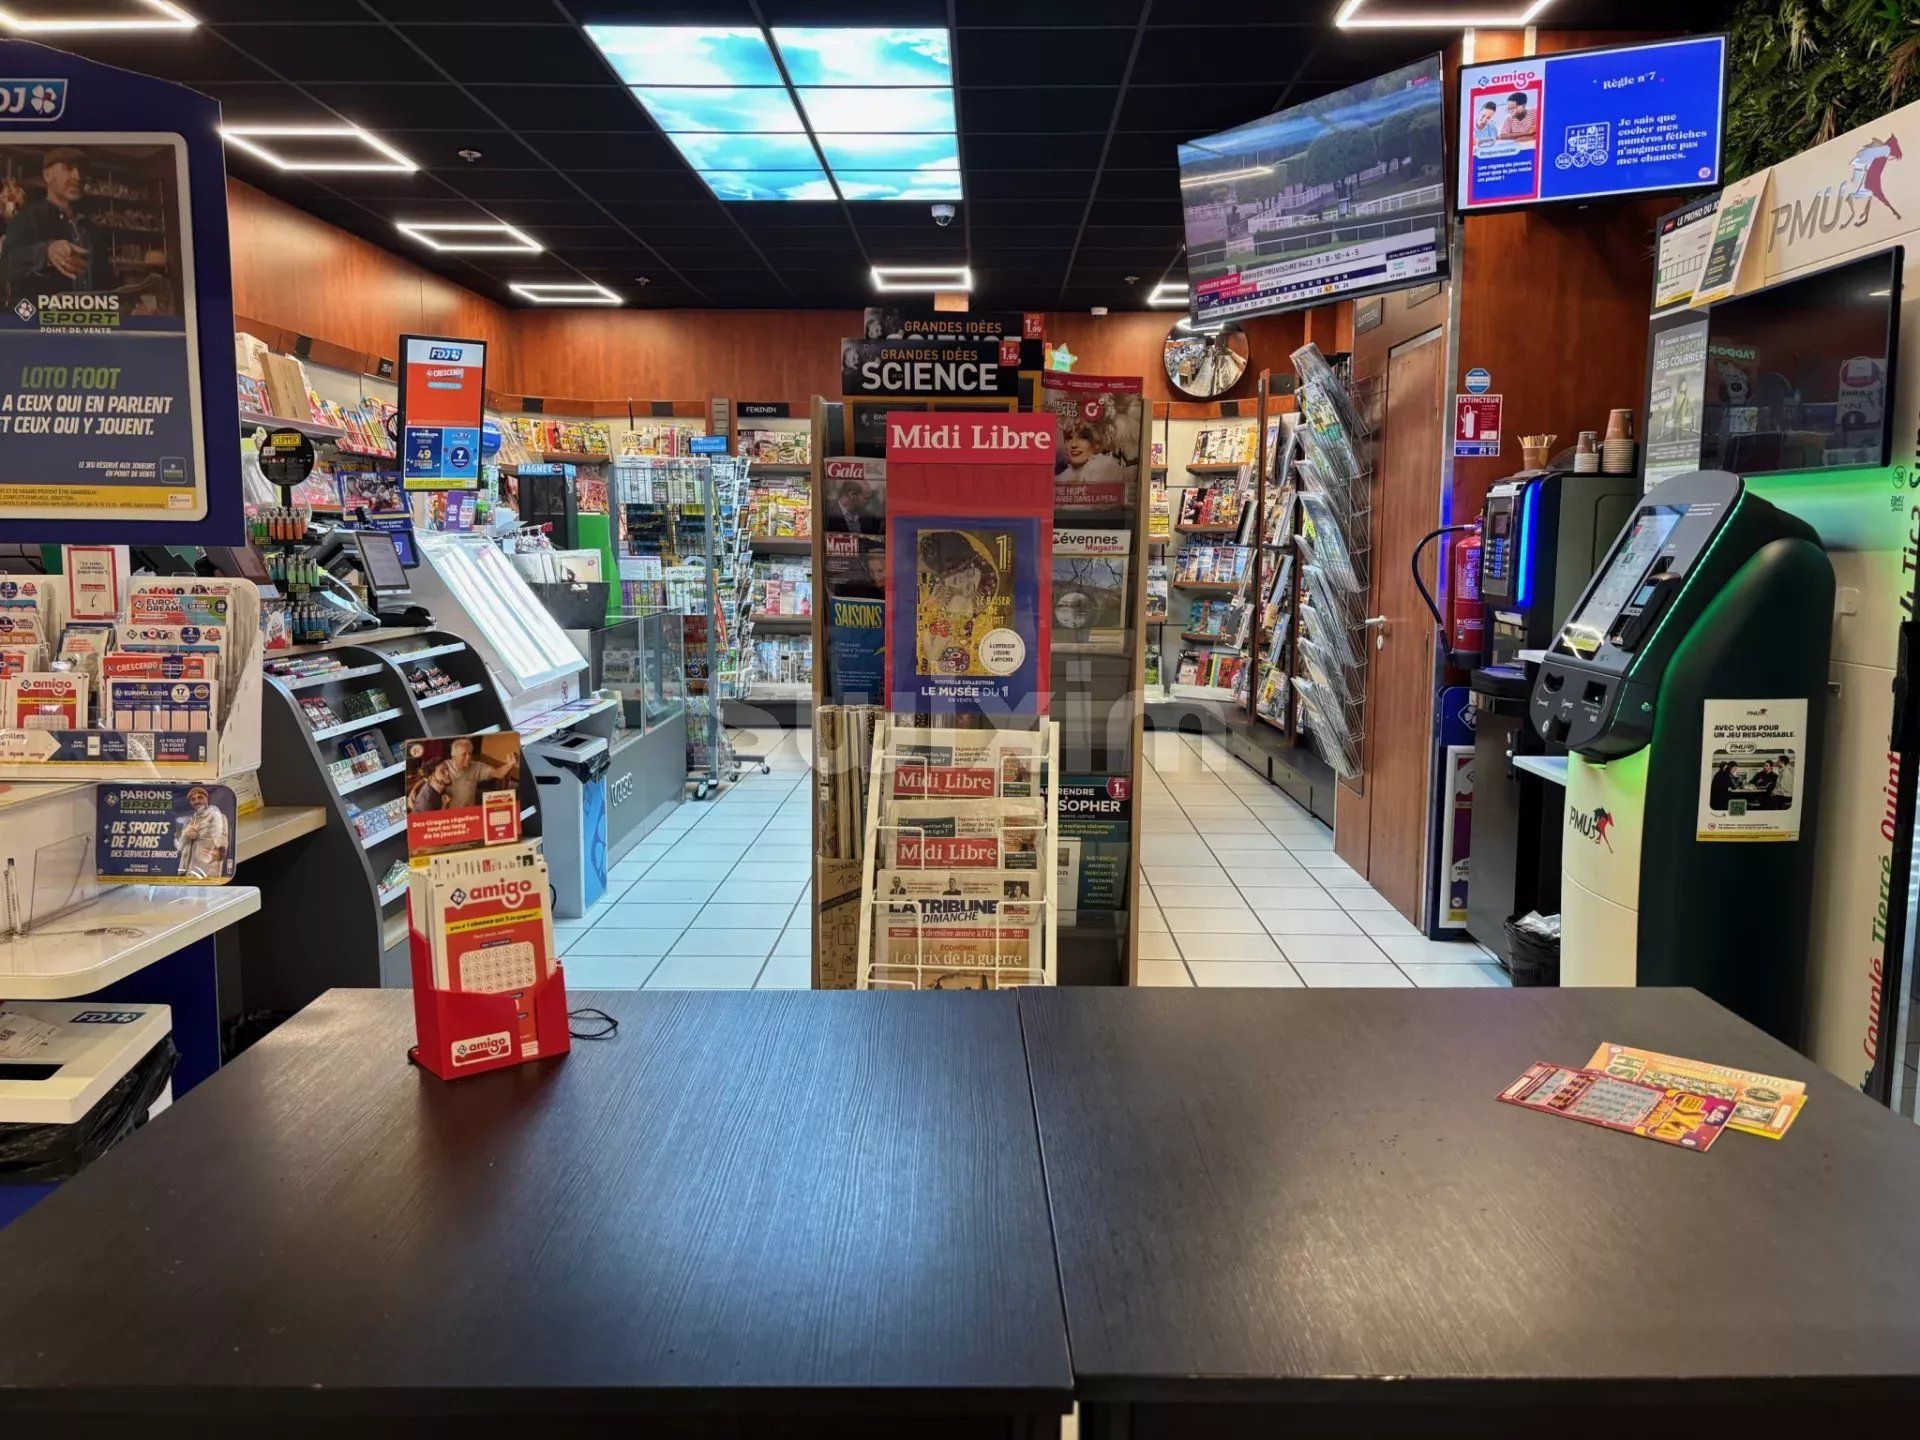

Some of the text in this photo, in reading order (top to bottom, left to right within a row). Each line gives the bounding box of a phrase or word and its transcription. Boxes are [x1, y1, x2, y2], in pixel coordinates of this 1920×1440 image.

[1491, 70, 1536, 87] amigo
[1603, 71, 1657, 90] Règle n°7
[1618, 114, 1676, 127] Je sais que
[1618, 124, 1678, 136] cocher mes
[1617, 130, 1707, 146] numéros fétiches
[1617, 141, 1698, 156] n'augmente pas
[1616, 152, 1686, 166] mes chances.
[1684, 208, 1704, 224] PRONO
[1704, 204, 1712, 215] DU
[1768, 182, 1848, 253] PMU
[1264, 262, 1298, 275] PROVISOIRE
[38, 294, 120, 310] PARIONS
[41, 312, 118, 324] SPORT
[40, 326, 67, 334] POINT
[904, 318, 1002, 334] GRANDES IDÉES
[432, 350, 450, 360] FDJ
[880, 346, 978, 361] GRANDES IDÉES
[1656, 359, 1669, 370] DES
[21, 366, 122, 390] LOTO FOOT
[862, 362, 998, 391] SCIENCE
[2, 394, 174, 414] A CEUX QUI EN PARLENT
[745, 406, 777, 414] FEMININ
[14, 416, 154, 436] CEUX QUI Y JOUENT.
[892, 424, 1050, 450] Midi Libre
[418, 450, 431, 458] 49
[456, 450, 464, 459] 7
[96, 461, 118, 469] RÉSERVÉ
[119, 462, 132, 470] AUX
[828, 462, 864, 478] Gala
[826, 537, 858, 554] MATCH
[1085, 544, 1124, 553] Magazine
[146, 598, 170, 606] EURO
[834, 602, 883, 628] SAISONS
[116, 662, 158, 672] CRESCENDO
[33, 678, 72, 694] amigo
[922, 685, 1009, 697] LE MUSÉE DU 1
[944, 771, 992, 790] Libre
[120, 790, 172, 800] PARIONS
[1880, 750, 1901, 844] Quint
[426, 818, 450, 827] tirages
[450, 814, 480, 823] réguliers
[452, 823, 466, 831] long
[1568, 806, 1596, 838] PMU
[112, 821, 170, 834] DE SPORTS
[110, 835, 161, 848] DE PARIS
[423, 832, 432, 840] de
[440, 830, 465, 838] journée
[111, 850, 178, 858] DES SERVICES ENRICHIS
[900, 843, 997, 860] Mdi Libre
[470, 878, 532, 906] amigo
[888, 899, 999, 914] LA TRIBUNE
[470, 918, 494, 928] chance
[922, 912, 978, 924] DIMANCHE
[926, 929, 976, 938] dernière année
[940, 943, 977, 951] ÉCONOMIE
[894, 951, 1022, 967] Le de la guerre
[77, 1012, 115, 1022] FDJ
[469, 1037, 506, 1052] amigo
